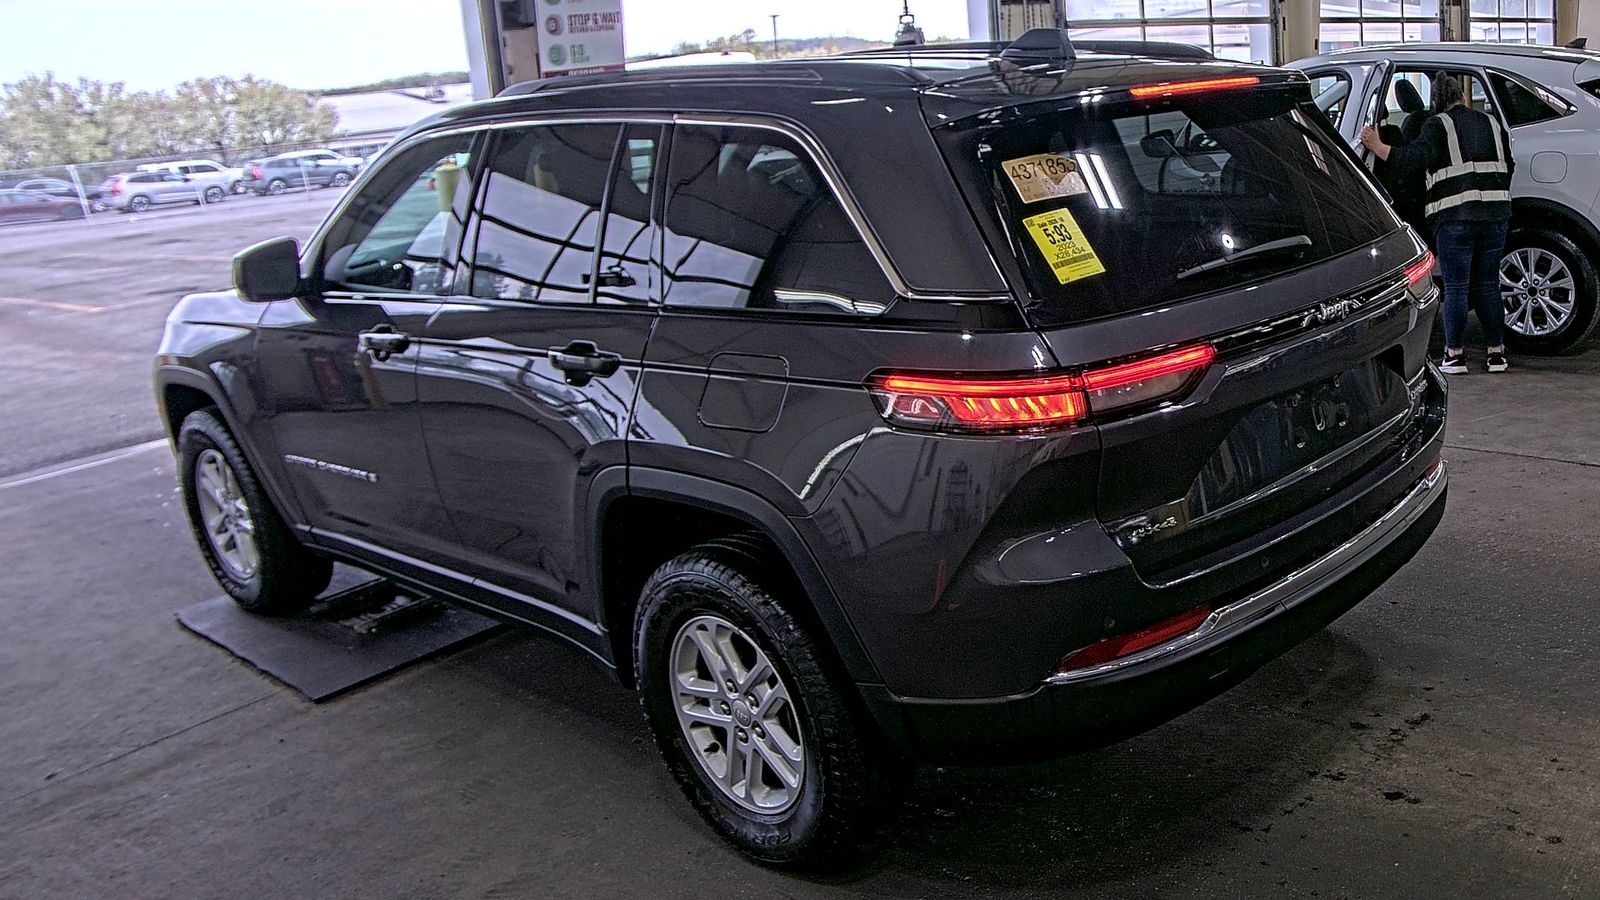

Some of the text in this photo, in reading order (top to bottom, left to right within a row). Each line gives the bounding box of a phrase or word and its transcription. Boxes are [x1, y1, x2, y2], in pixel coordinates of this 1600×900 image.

[567, 13, 590, 26] STOP
[600, 11, 621, 24] WAIT
[1056, 241, 1077, 252] 2023
